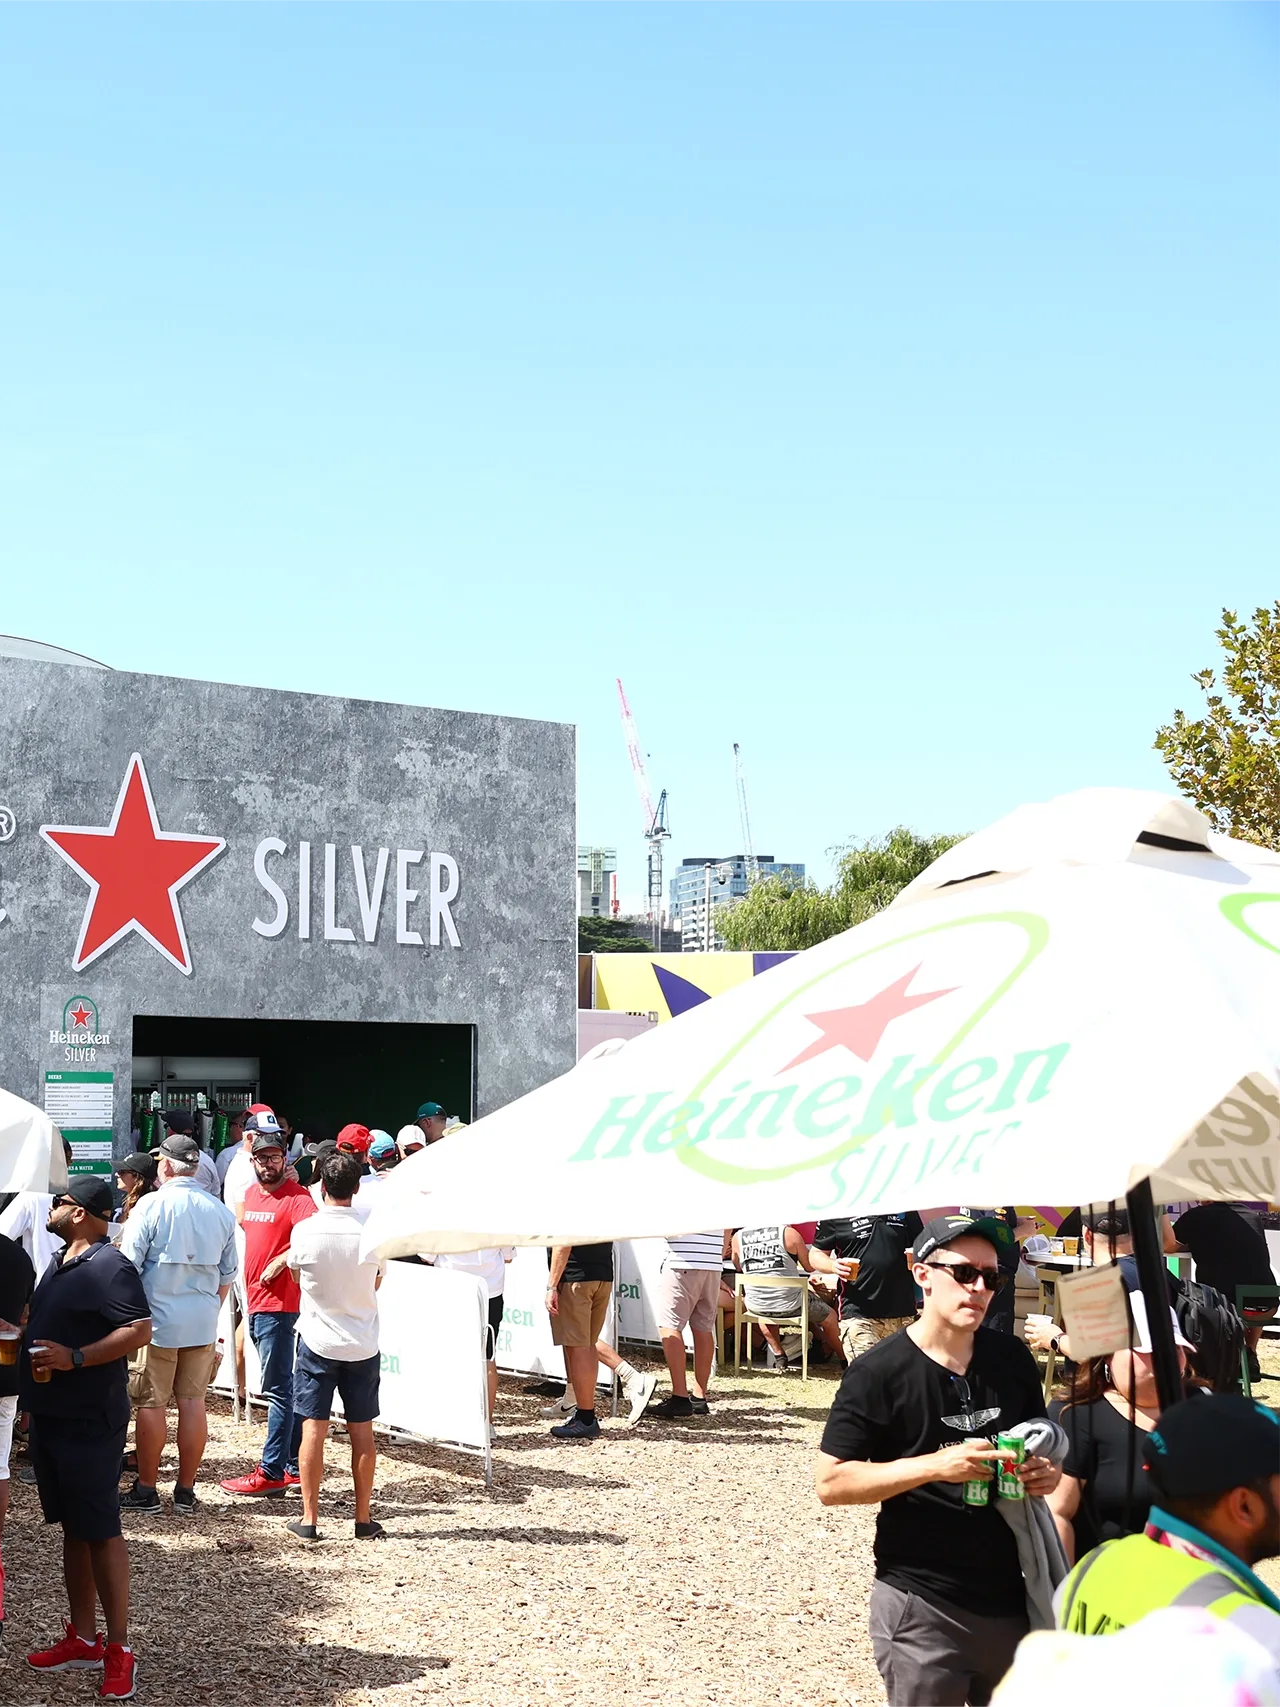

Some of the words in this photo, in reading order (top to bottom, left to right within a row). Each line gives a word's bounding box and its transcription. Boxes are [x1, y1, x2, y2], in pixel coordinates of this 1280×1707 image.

[250, 837, 462, 948] SILVER
[49, 1030, 111, 1045] Heineken
[64, 1047, 96, 1062] SILVER
[566, 1043, 1071, 1163] Heineken
